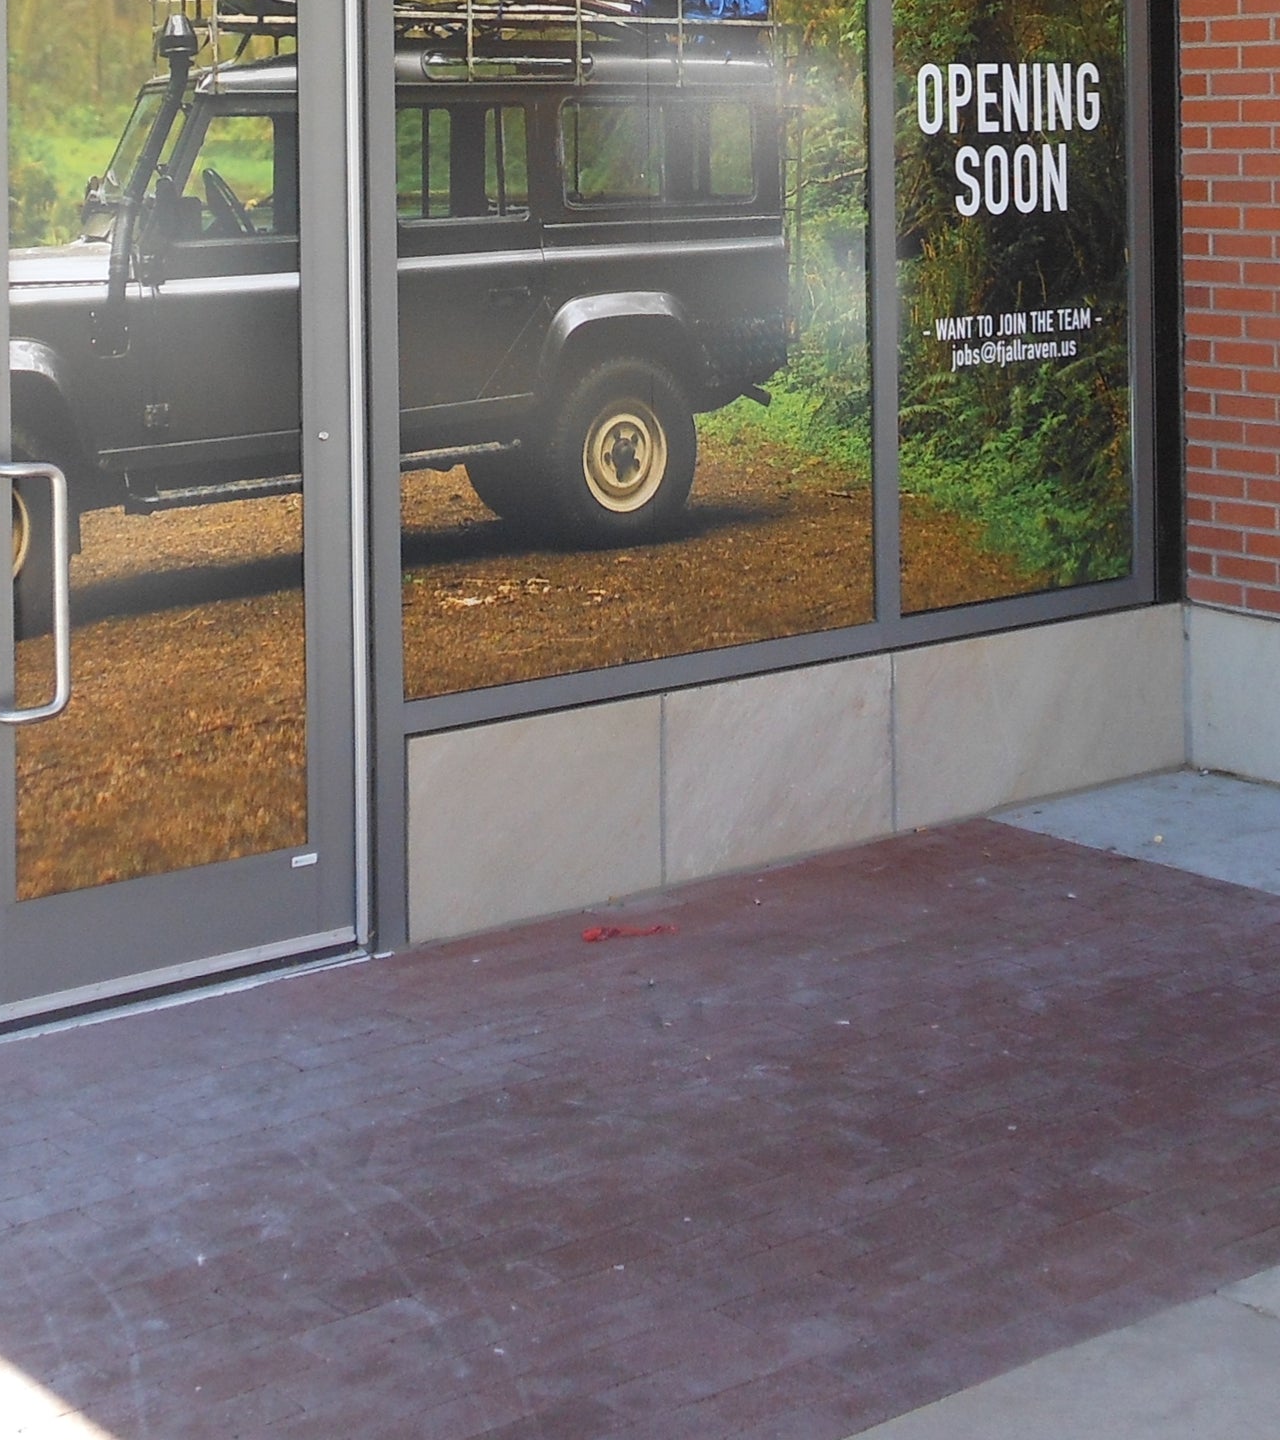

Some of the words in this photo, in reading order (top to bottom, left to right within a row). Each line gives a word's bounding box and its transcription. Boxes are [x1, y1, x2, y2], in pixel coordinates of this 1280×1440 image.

[917, 62, 1101, 135] OPENING
[955, 143, 1068, 217] SOON
[935, 316, 973, 341] WANT
[977, 314, 993, 338] TO
[996, 312, 1026, 336] JOIN
[1030, 310, 1054, 334] THE
[1057, 307, 1091, 331] TEAM
[951, 339, 1077, 373] jobs@fjallraven.us
